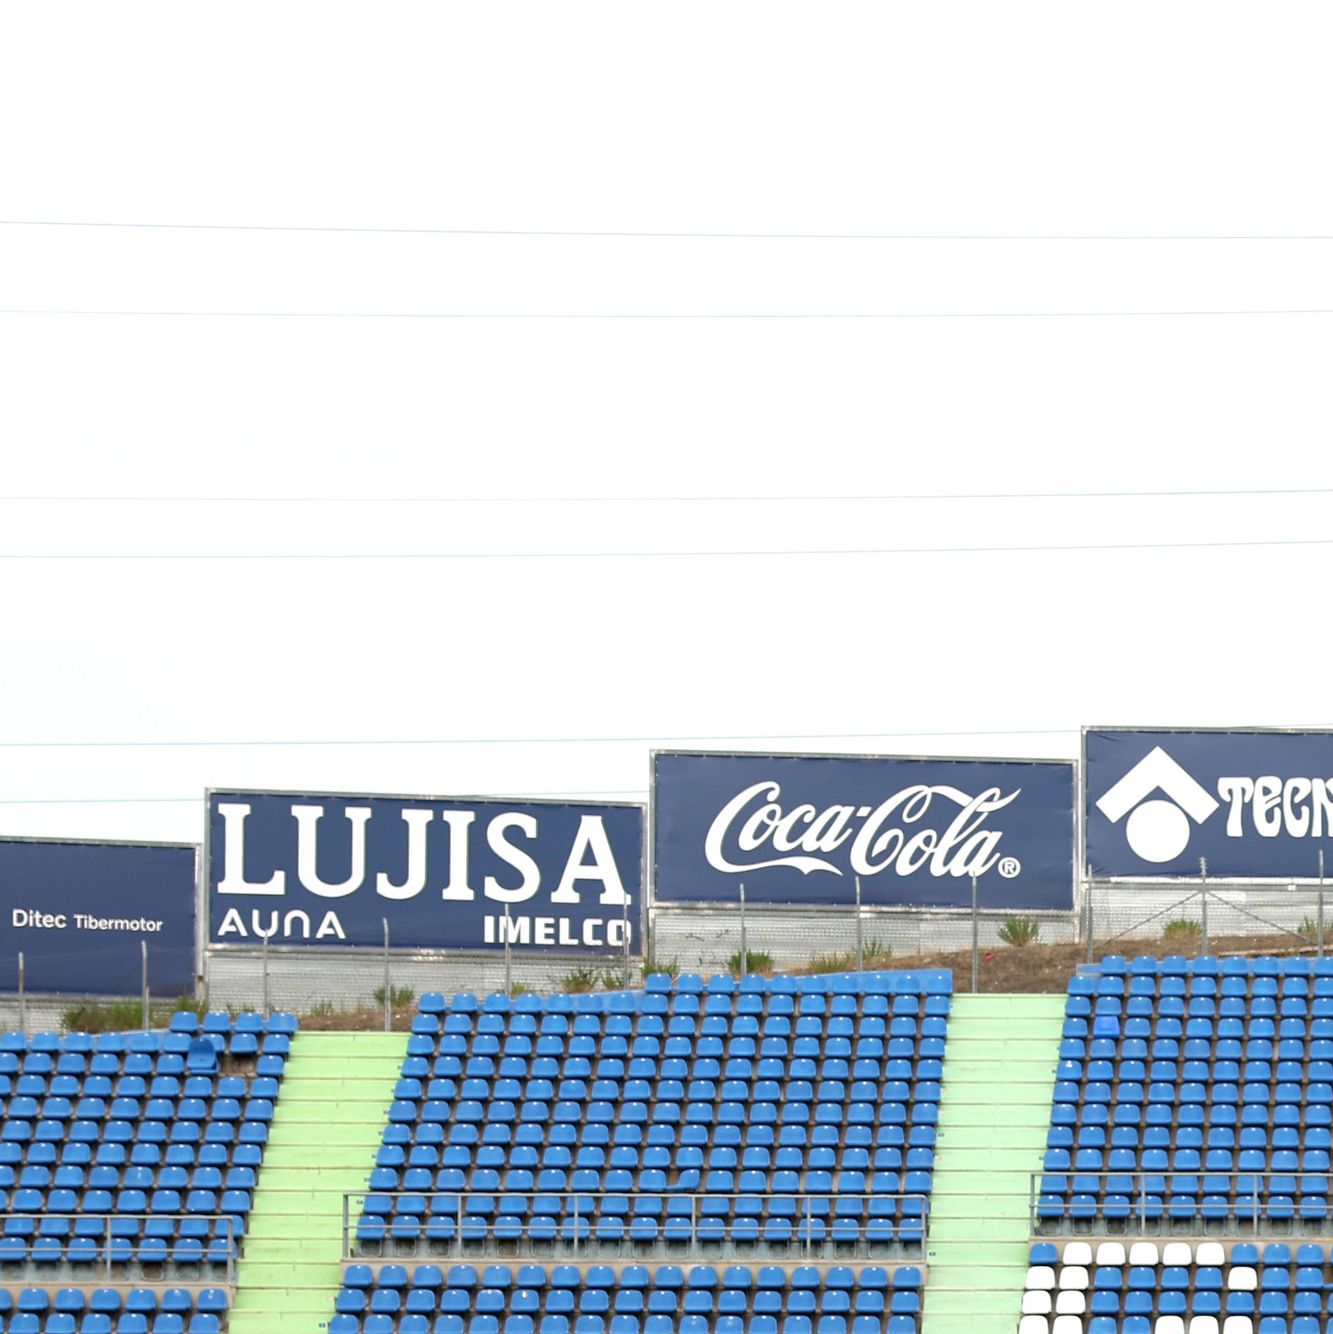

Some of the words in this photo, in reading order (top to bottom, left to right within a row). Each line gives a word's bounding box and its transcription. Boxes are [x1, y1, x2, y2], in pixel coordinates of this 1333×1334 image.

[218, 803, 632, 904] LUJISA
[12, 908, 67, 929] Ditec
[73, 914, 163, 932] Tibermotor
[484, 915, 632, 946] IMELCO
